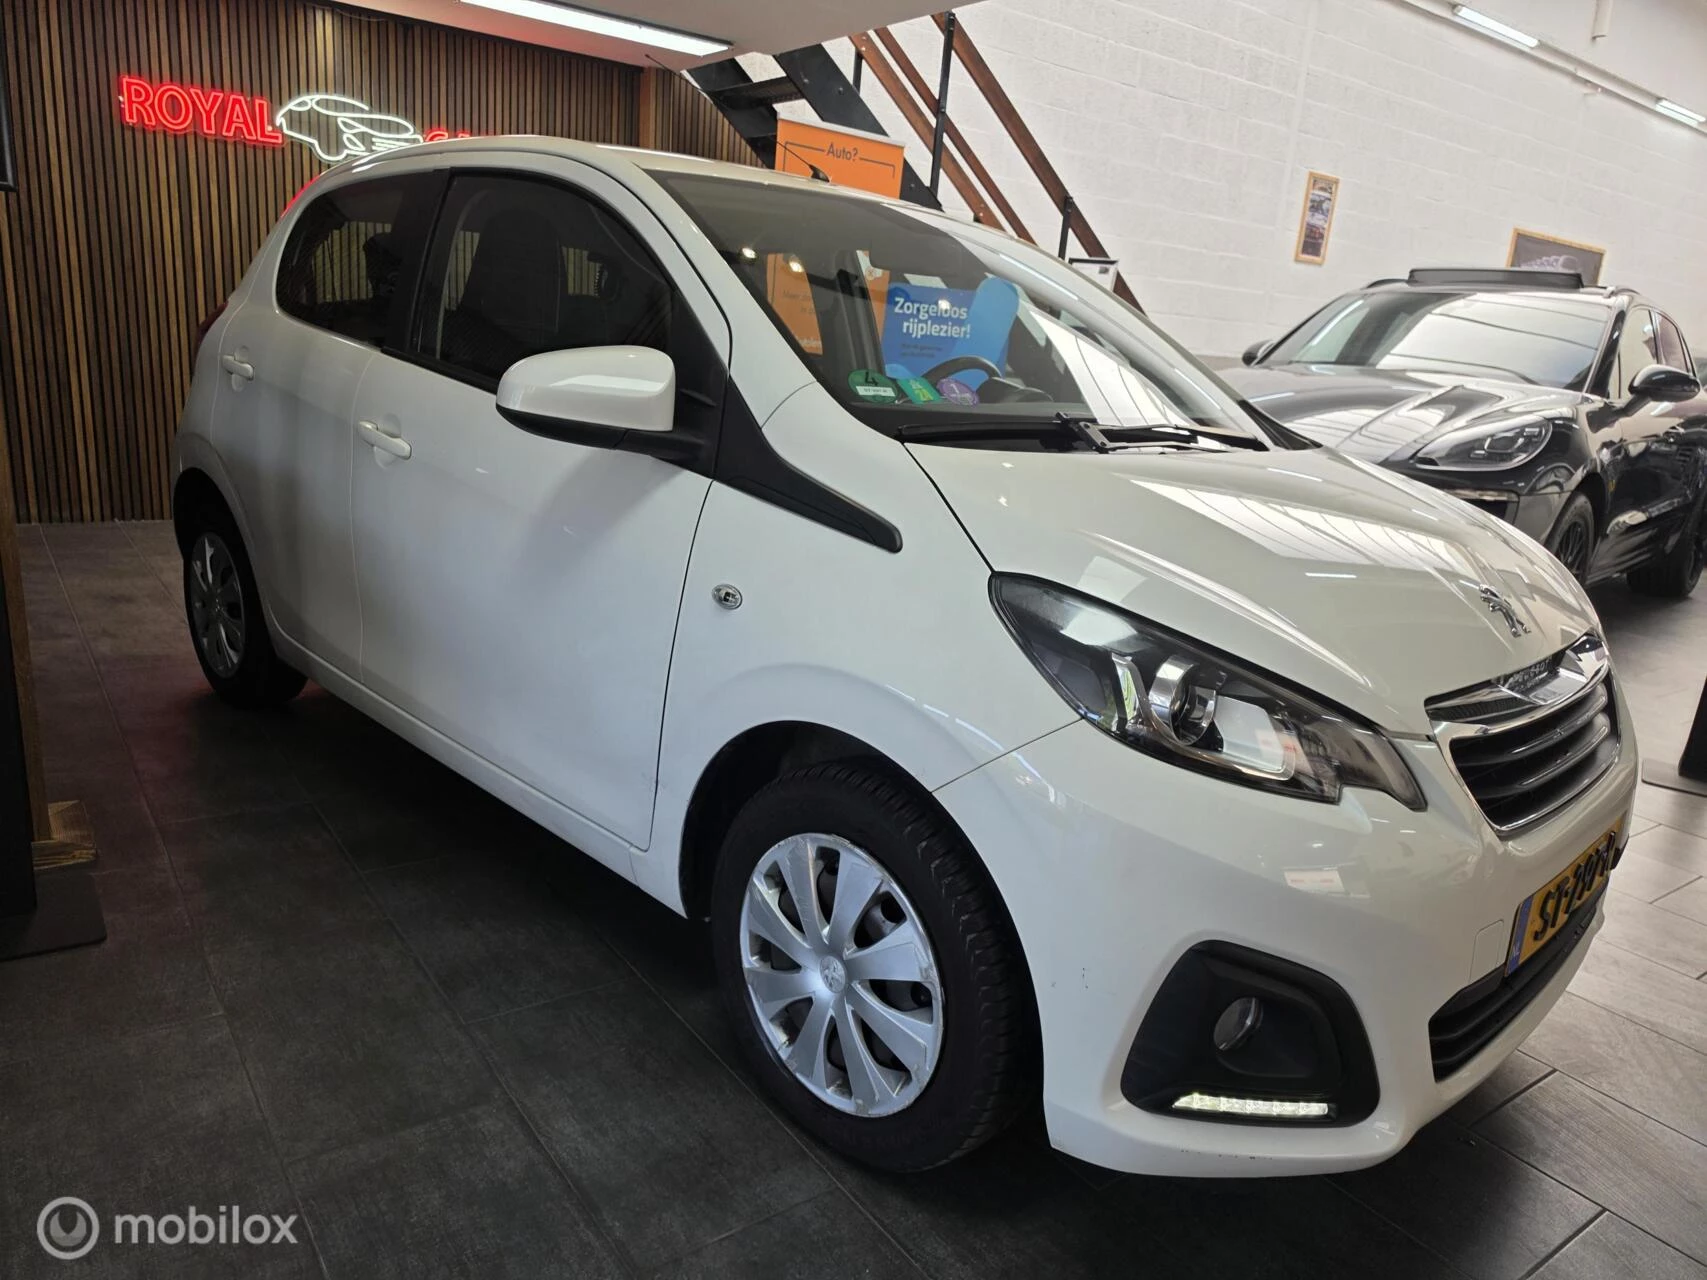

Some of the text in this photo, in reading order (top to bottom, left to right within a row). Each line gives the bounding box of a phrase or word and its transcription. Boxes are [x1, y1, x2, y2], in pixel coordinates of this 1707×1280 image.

[122, 76, 283, 144] ROYAL
[826, 141, 859, 162] Auto?
[894, 296, 968, 320] Zorgeloos
[902, 318, 971, 339] rijplezier!
